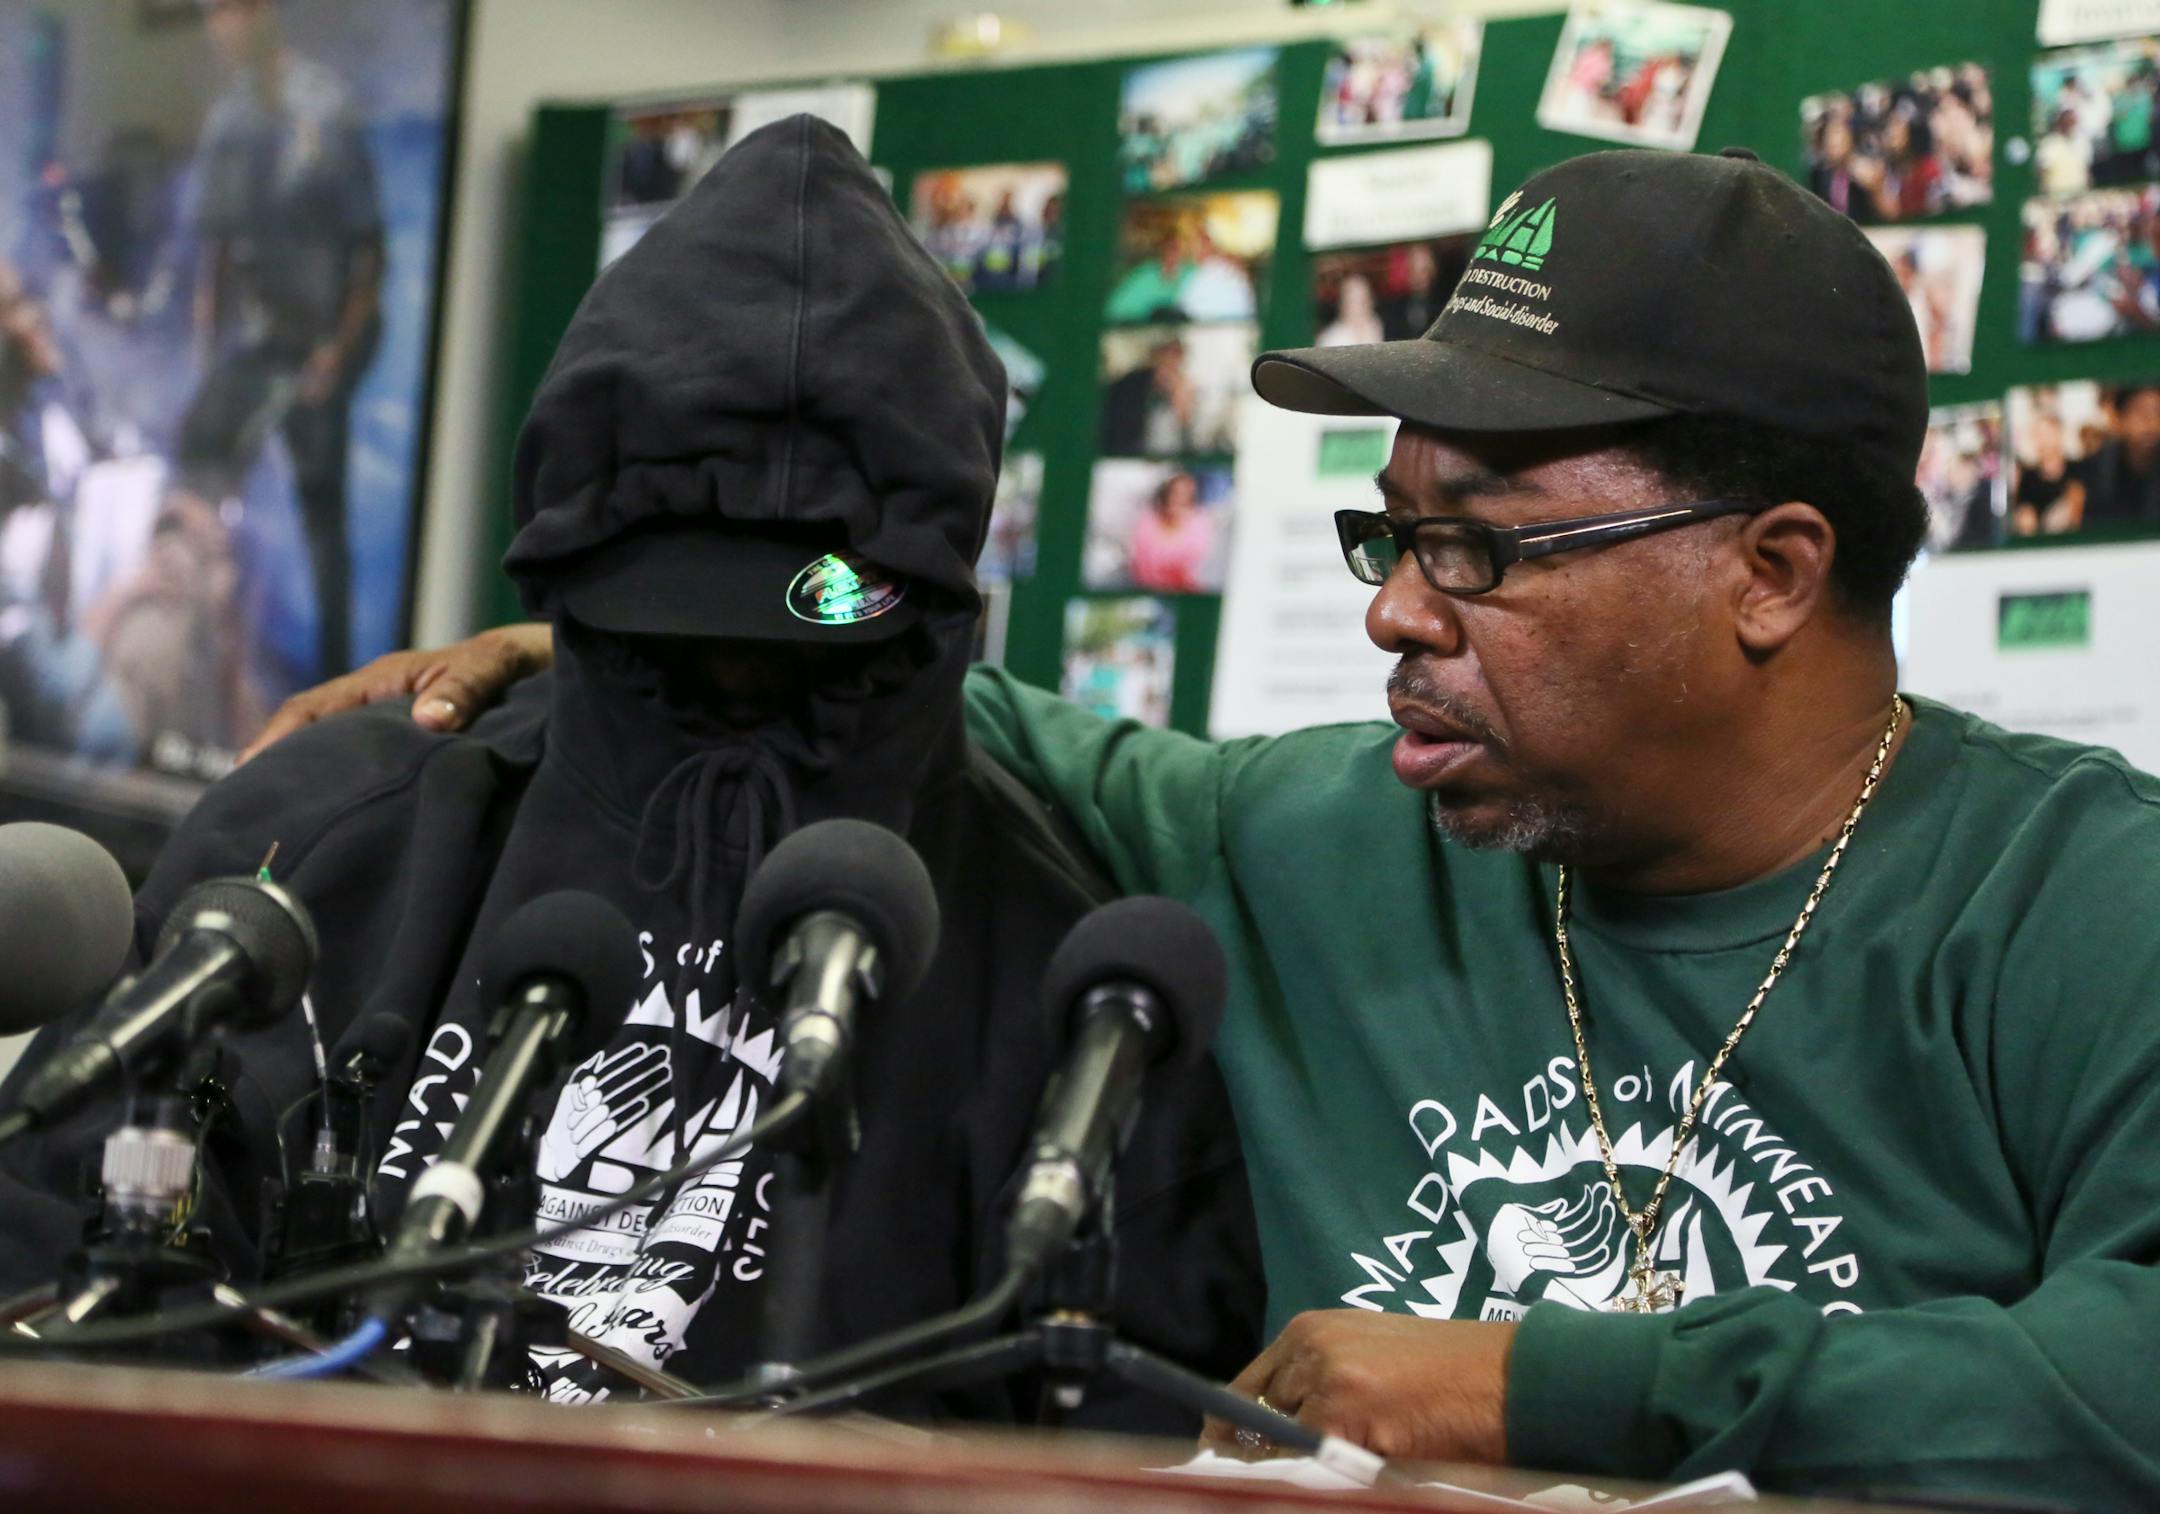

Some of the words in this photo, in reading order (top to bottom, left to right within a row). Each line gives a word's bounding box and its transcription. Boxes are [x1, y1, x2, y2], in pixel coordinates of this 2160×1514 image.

[1469, 268, 1552, 301] DESTRUCTION
[1341, 1172, 1449, 1312] MAD
[1408, 1056, 1576, 1160] DADS
